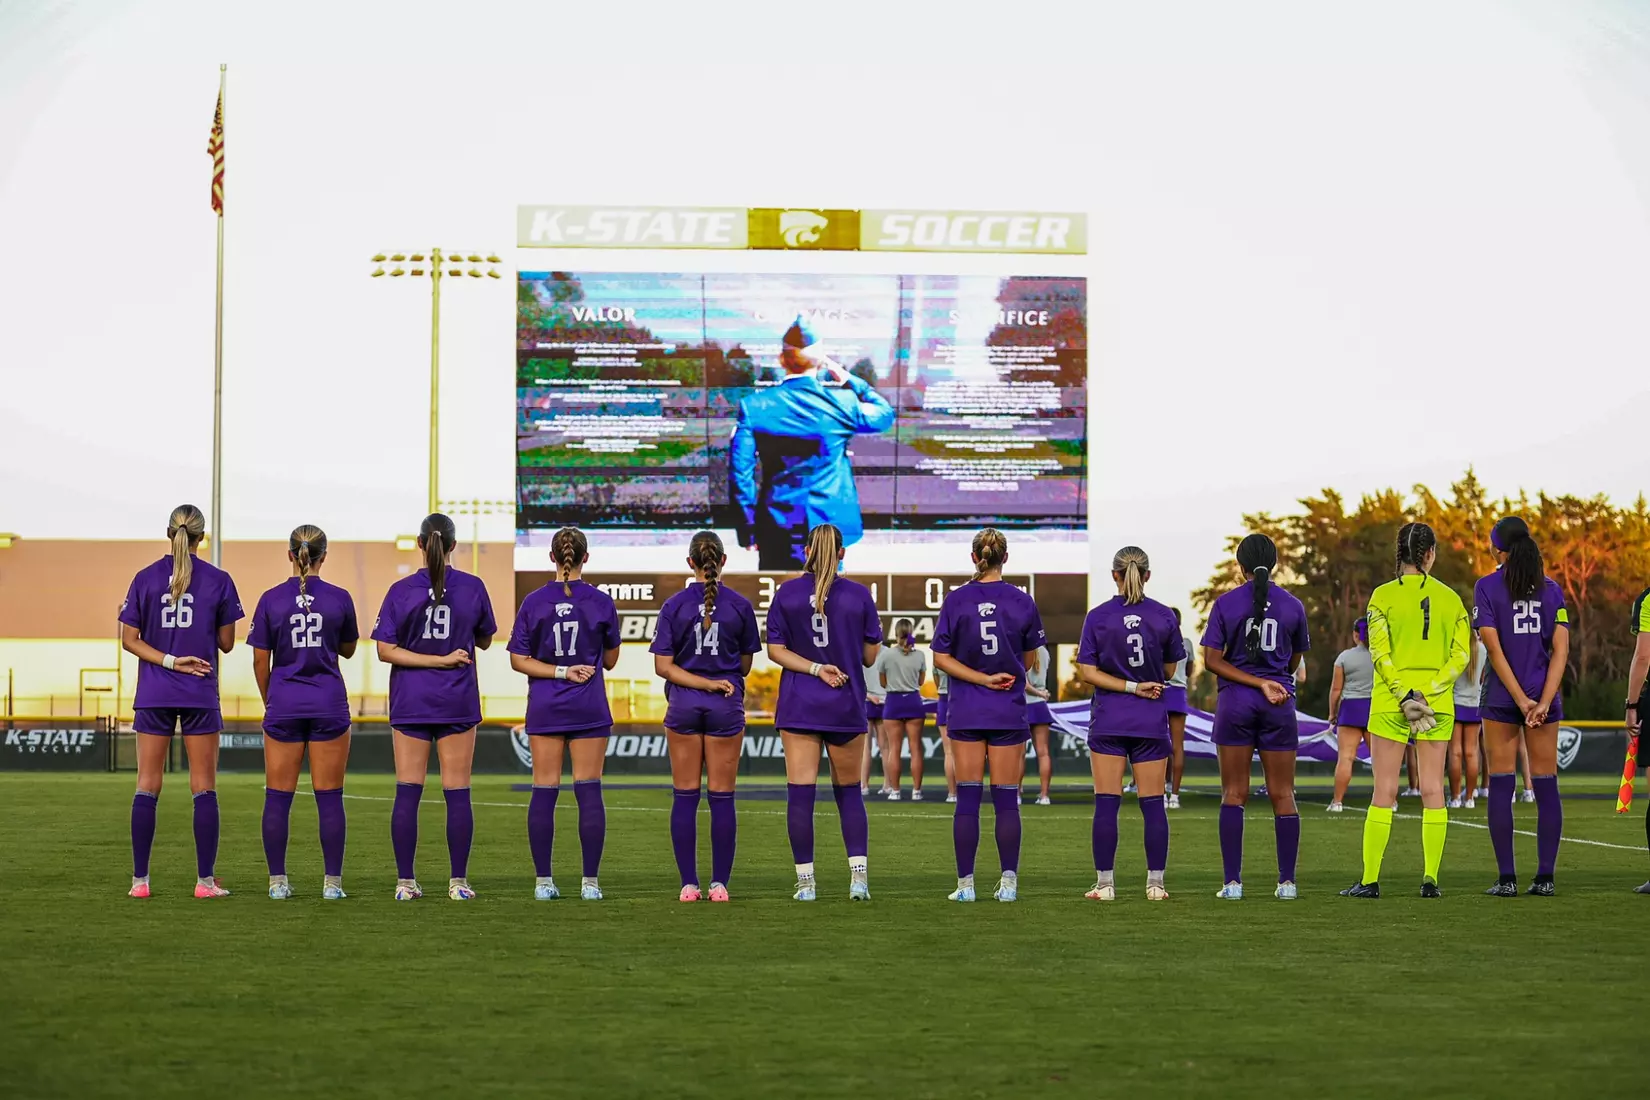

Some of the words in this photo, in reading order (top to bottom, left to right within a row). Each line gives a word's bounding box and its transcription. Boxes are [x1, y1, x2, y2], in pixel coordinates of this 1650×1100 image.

[529, 209, 737, 243] K-STATE
[877, 213, 1072, 249] SOCCER
[571, 306, 637, 322] VALOR
[949, 310, 1049, 326] SIFICE
[161, 593, 194, 628] 26
[422, 604, 451, 640] 19
[1420, 596, 1430, 640] 1
[1512, 600, 1542, 634] 25
[289, 612, 323, 649] 22
[552, 620, 579, 657] 17
[694, 622, 720, 656] 14
[811, 612, 829, 648] 9
[980, 620, 999, 656] 5
[1126, 633, 1145, 668] 3
[4, 729, 96, 746] K-STATE
[18, 745, 82, 754] SOCCER
